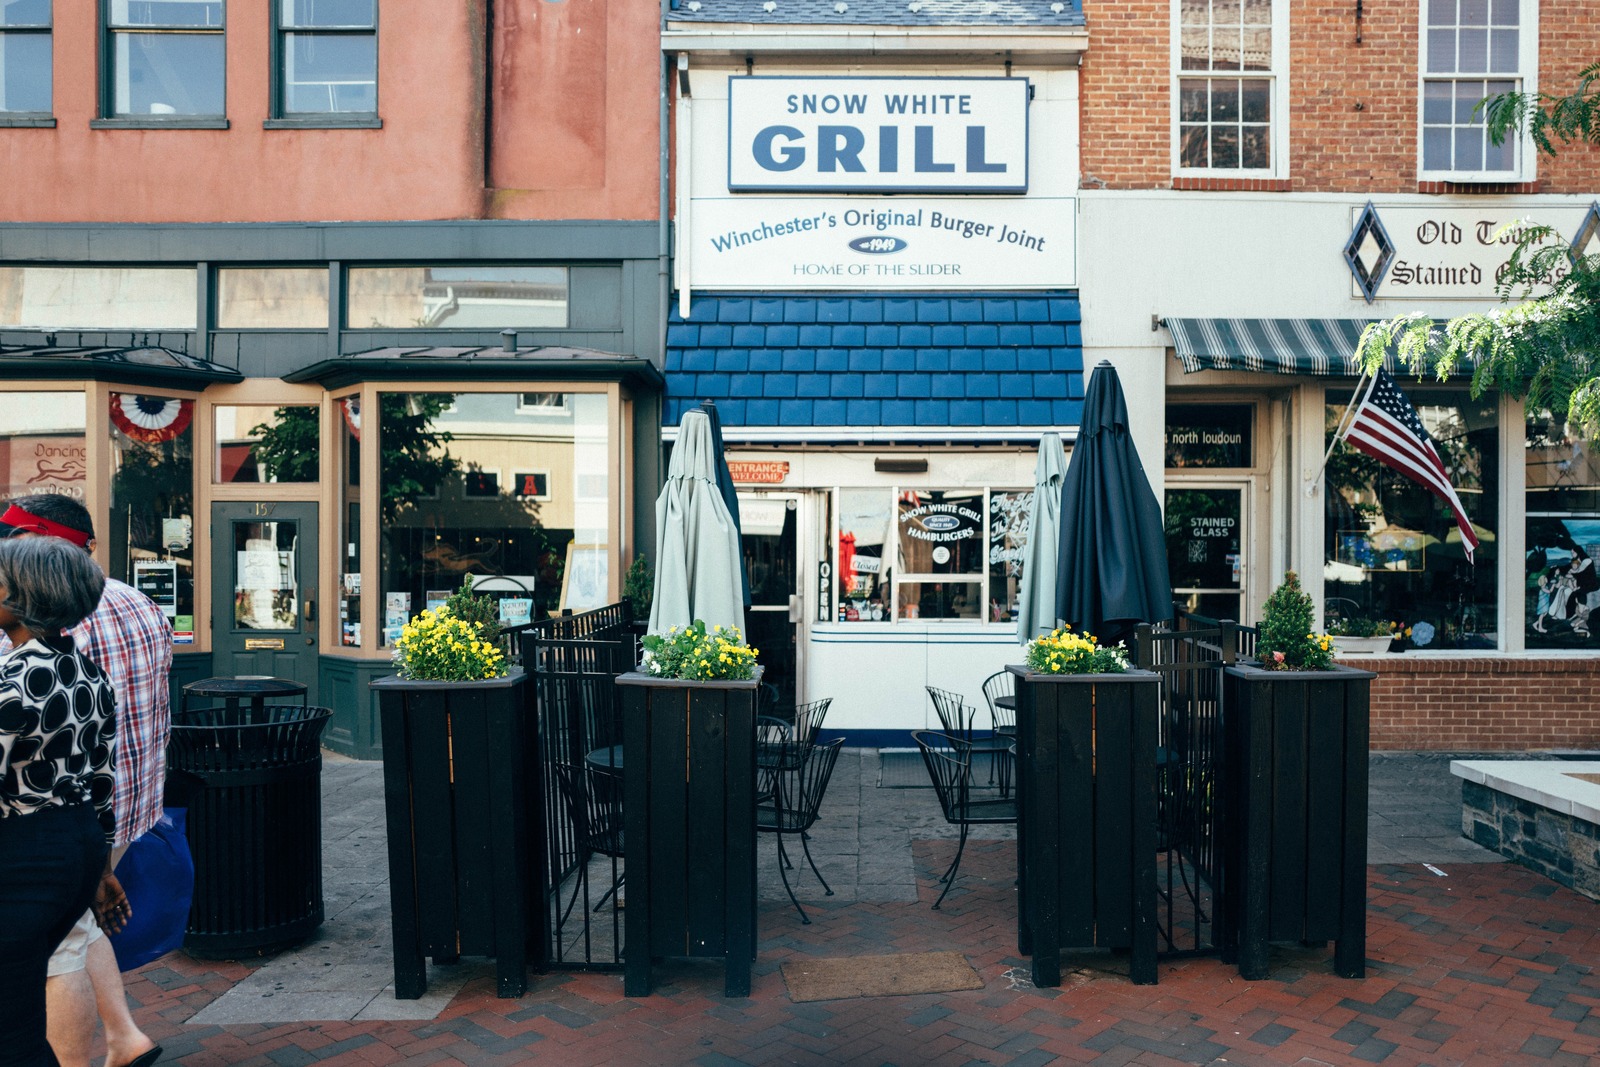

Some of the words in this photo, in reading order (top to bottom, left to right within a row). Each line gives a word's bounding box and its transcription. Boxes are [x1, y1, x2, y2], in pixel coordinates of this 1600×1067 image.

[787, 94, 868, 115] SNOW
[885, 94, 971, 115] WHITE
[752, 125, 1007, 173] GRILL
[711, 211, 837, 253] Winchester's
[844, 208, 922, 230] Original
[930, 211, 994, 239] Burger
[997, 224, 1046, 252] Joint
[1416, 219, 1462, 245] Old
[870, 238, 896, 251] 1949
[793, 263, 844, 275] HOME
[848, 263, 870, 275] OF
[874, 263, 905, 275] THE
[909, 263, 962, 275] SLIDER
[1391, 260, 1482, 286] Stained
[1172, 431, 1199, 445] north
[1202, 431, 1242, 445] loudoun
[34, 443, 86, 461] Dancing
[729, 463, 782, 473] ENTRANCE
[732, 472, 780, 480] WELCOME
[900, 505, 927, 523] SNOW
[928, 504, 958, 514] WHITE
[958, 506, 981, 523] GRILL
[1190, 517, 1235, 527] STAINED
[907, 526, 975, 542] HAMBURGERS
[1193, 527, 1229, 537] GLASS
[853, 561, 879, 571] Closed
[820, 562, 831, 621] OPEN
